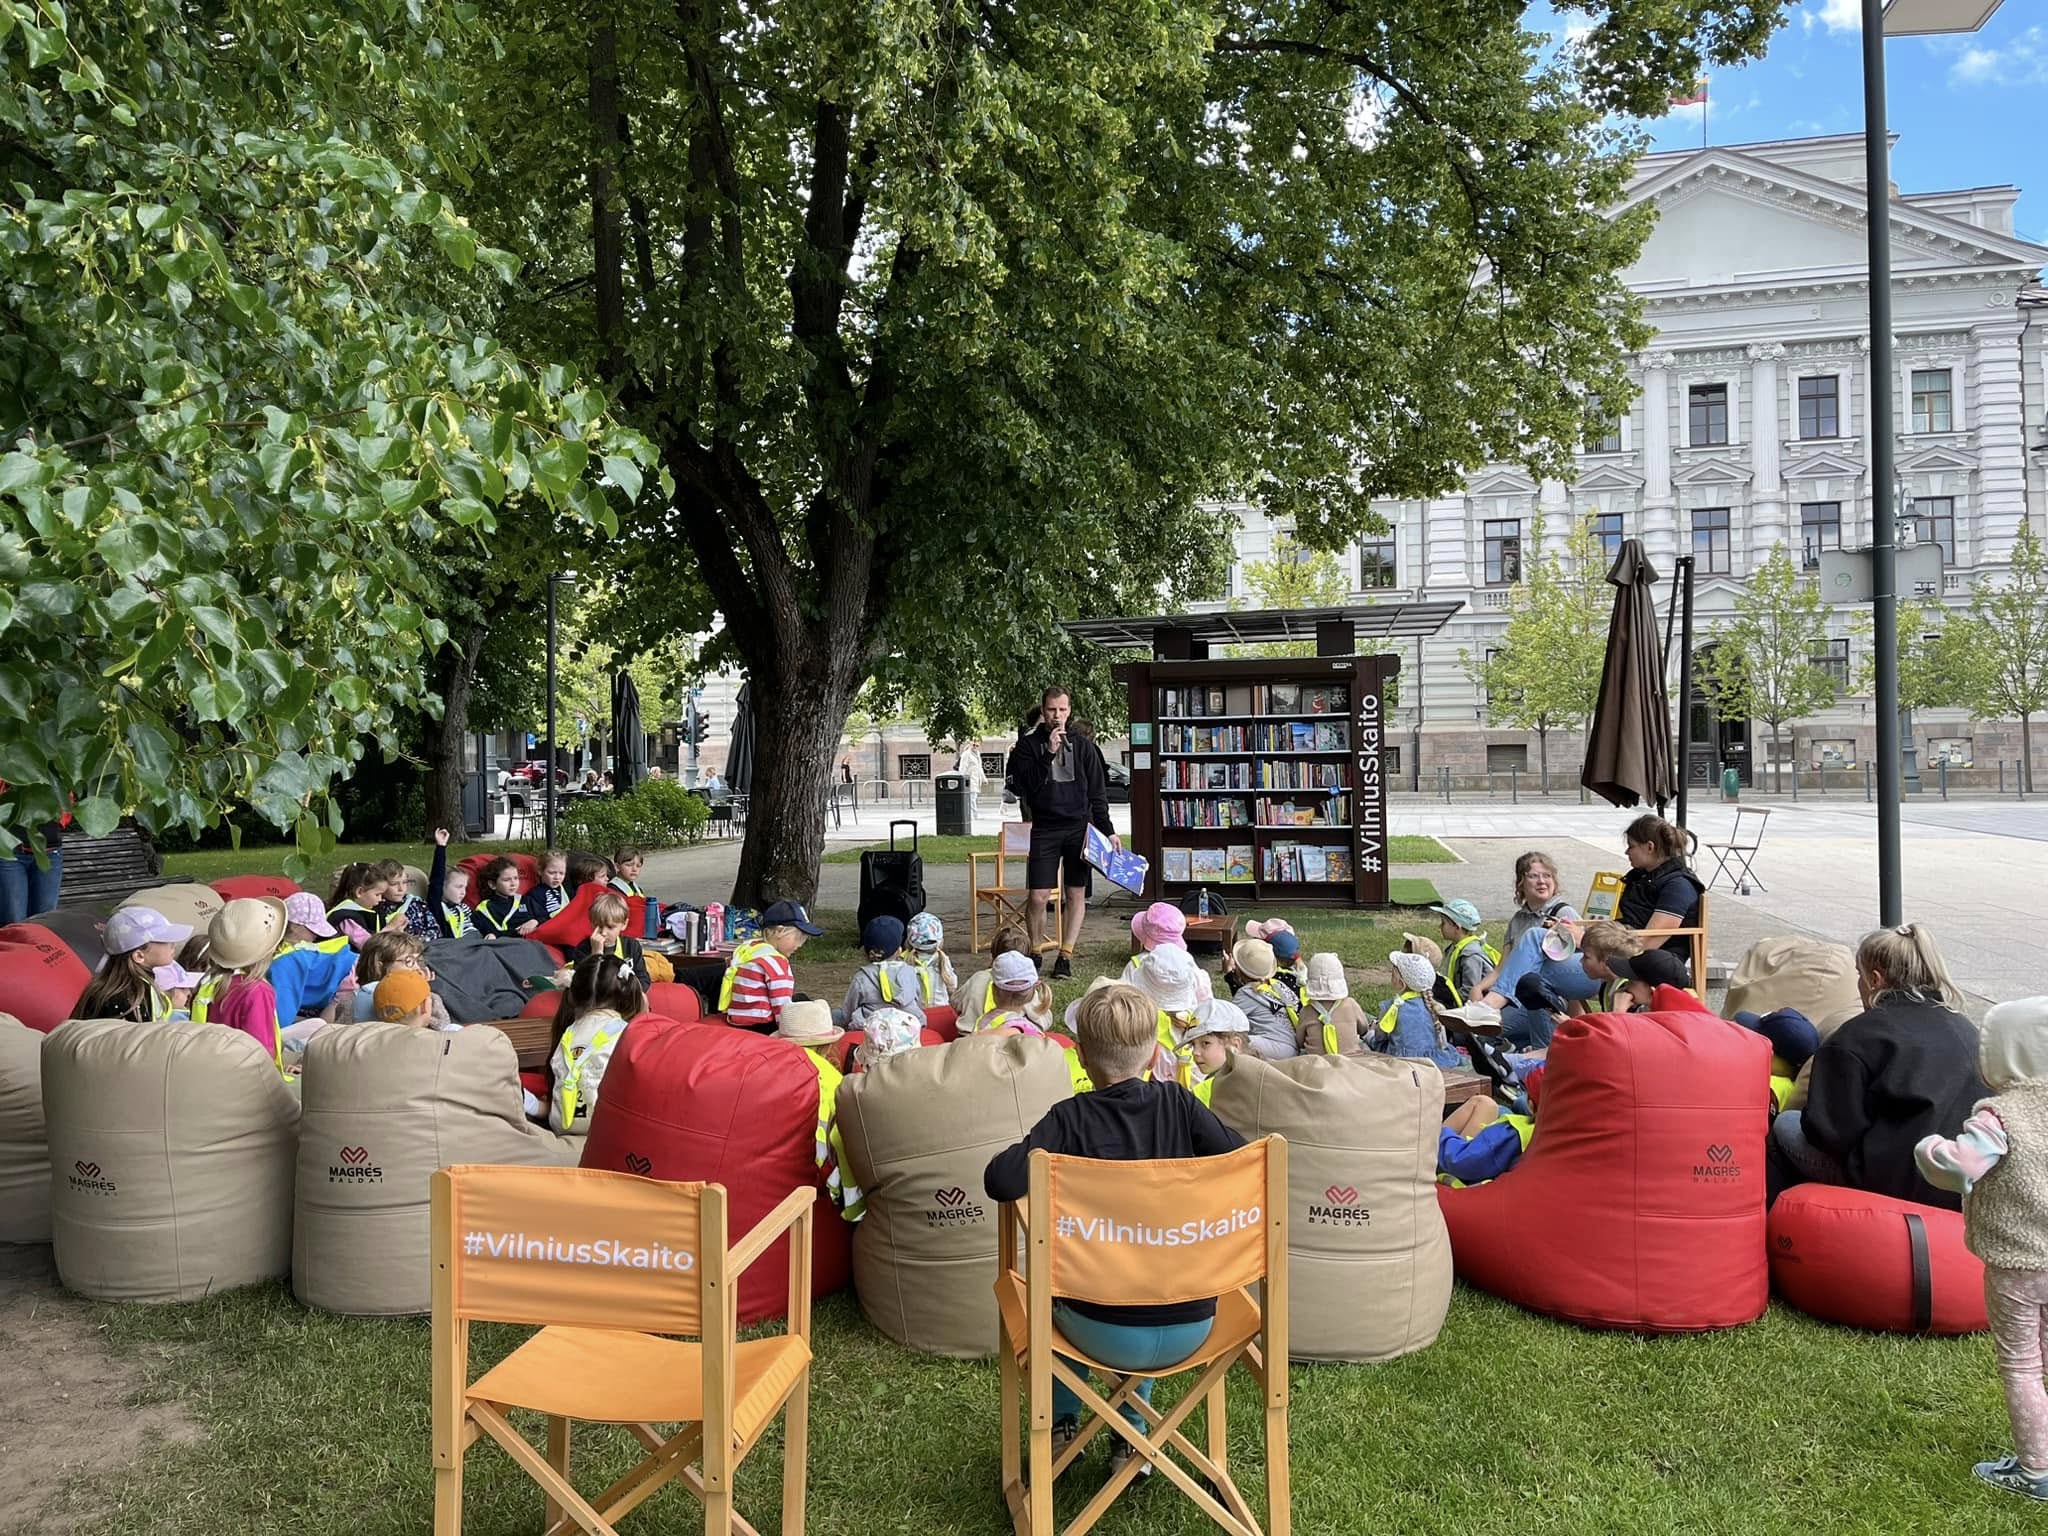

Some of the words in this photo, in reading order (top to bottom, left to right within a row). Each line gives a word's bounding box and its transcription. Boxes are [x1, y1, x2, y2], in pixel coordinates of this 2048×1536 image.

[1358, 694, 1381, 873] #VilniusSkaito
[329, 1163, 382, 1177] MAGRĖS
[69, 1176, 116, 1191] MAGRĖS
[926, 1201, 984, 1220] MAGRĖS
[1309, 1204, 1370, 1220] MAGRĖS
[1056, 1206, 1261, 1247] #VilniusSkaito
[1308, 1217, 1370, 1226] BALDAI
[464, 1231, 694, 1271] #VilniusSkaito
